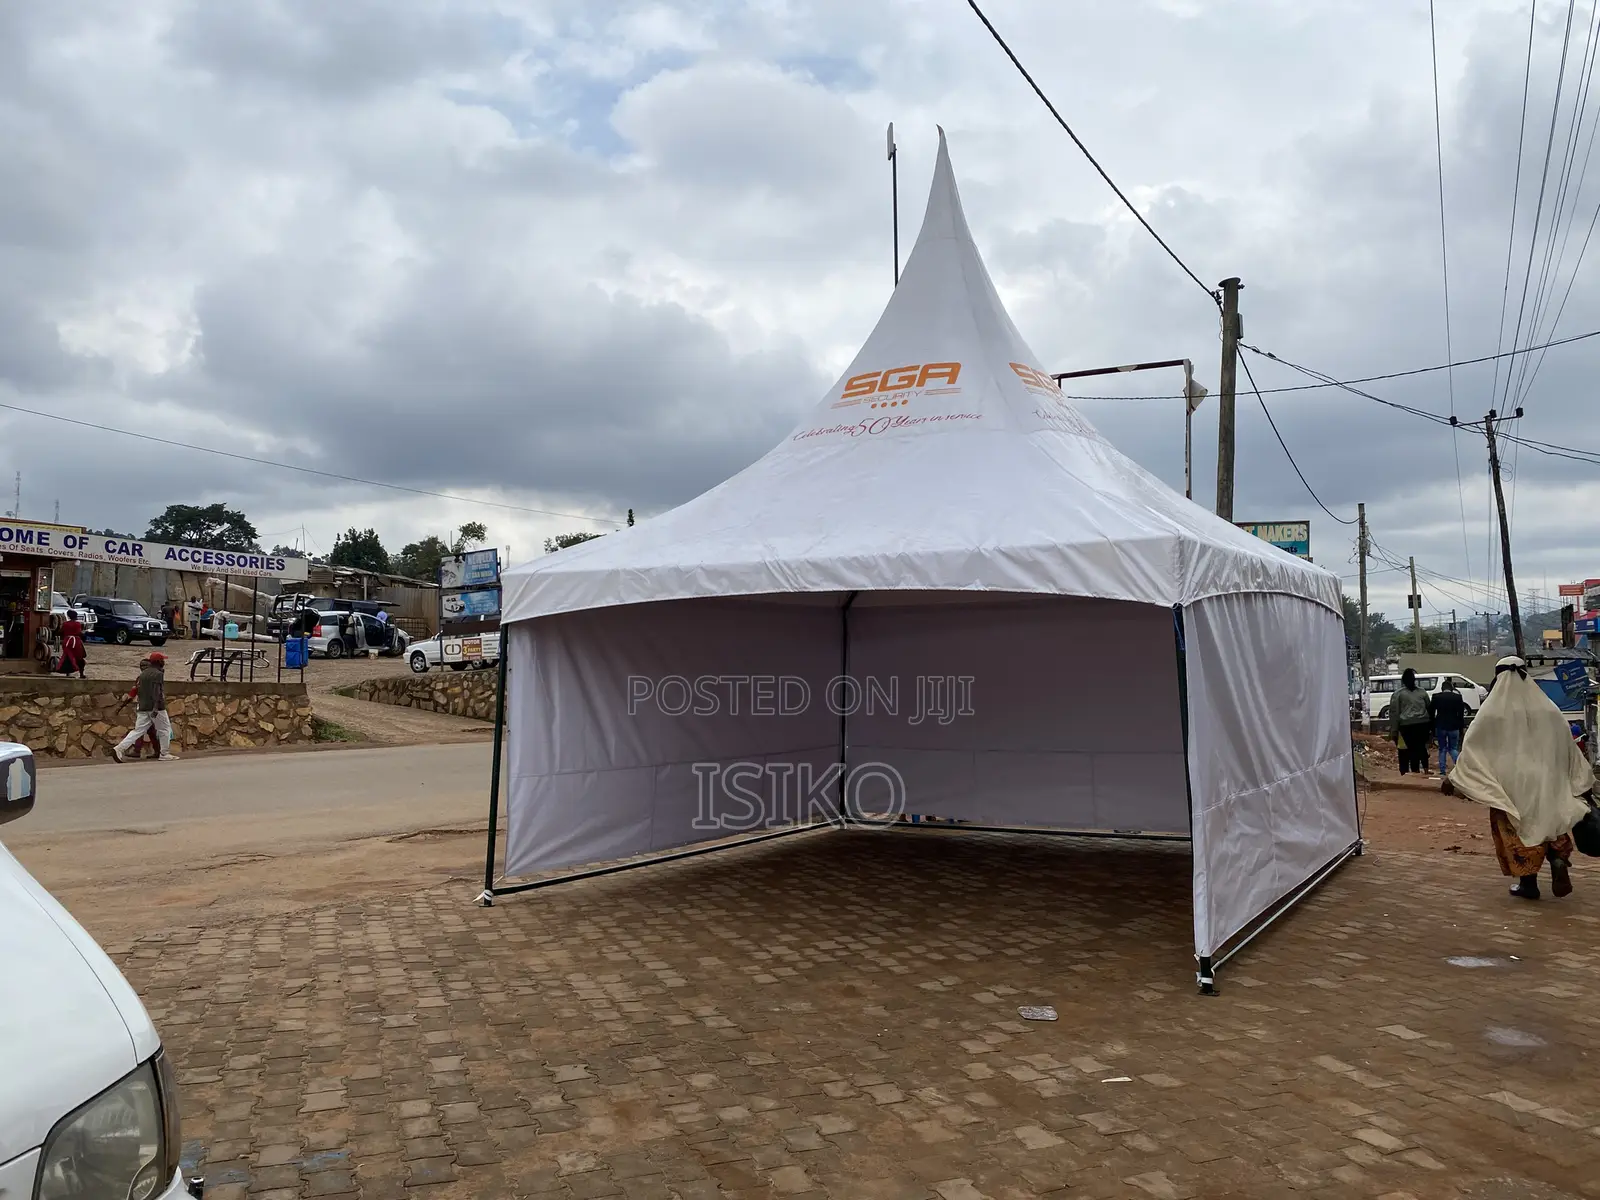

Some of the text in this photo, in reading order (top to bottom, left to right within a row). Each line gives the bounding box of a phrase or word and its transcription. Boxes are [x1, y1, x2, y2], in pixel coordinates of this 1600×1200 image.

[841, 362, 962, 399] SGA
[862, 390, 922, 403] SECURITY
[793, 424, 857, 441] Celebrating
[851, 416, 891, 437] 50
[63, 534, 89, 550] OF
[104, 540, 143, 557] CAR
[165, 547, 285, 571] ACCESSORIES
[108, 554, 137, 564] Woofers
[203, 564, 215, 573] Buy
[216, 566, 229, 574] And
[242, 568, 258, 576] Used
